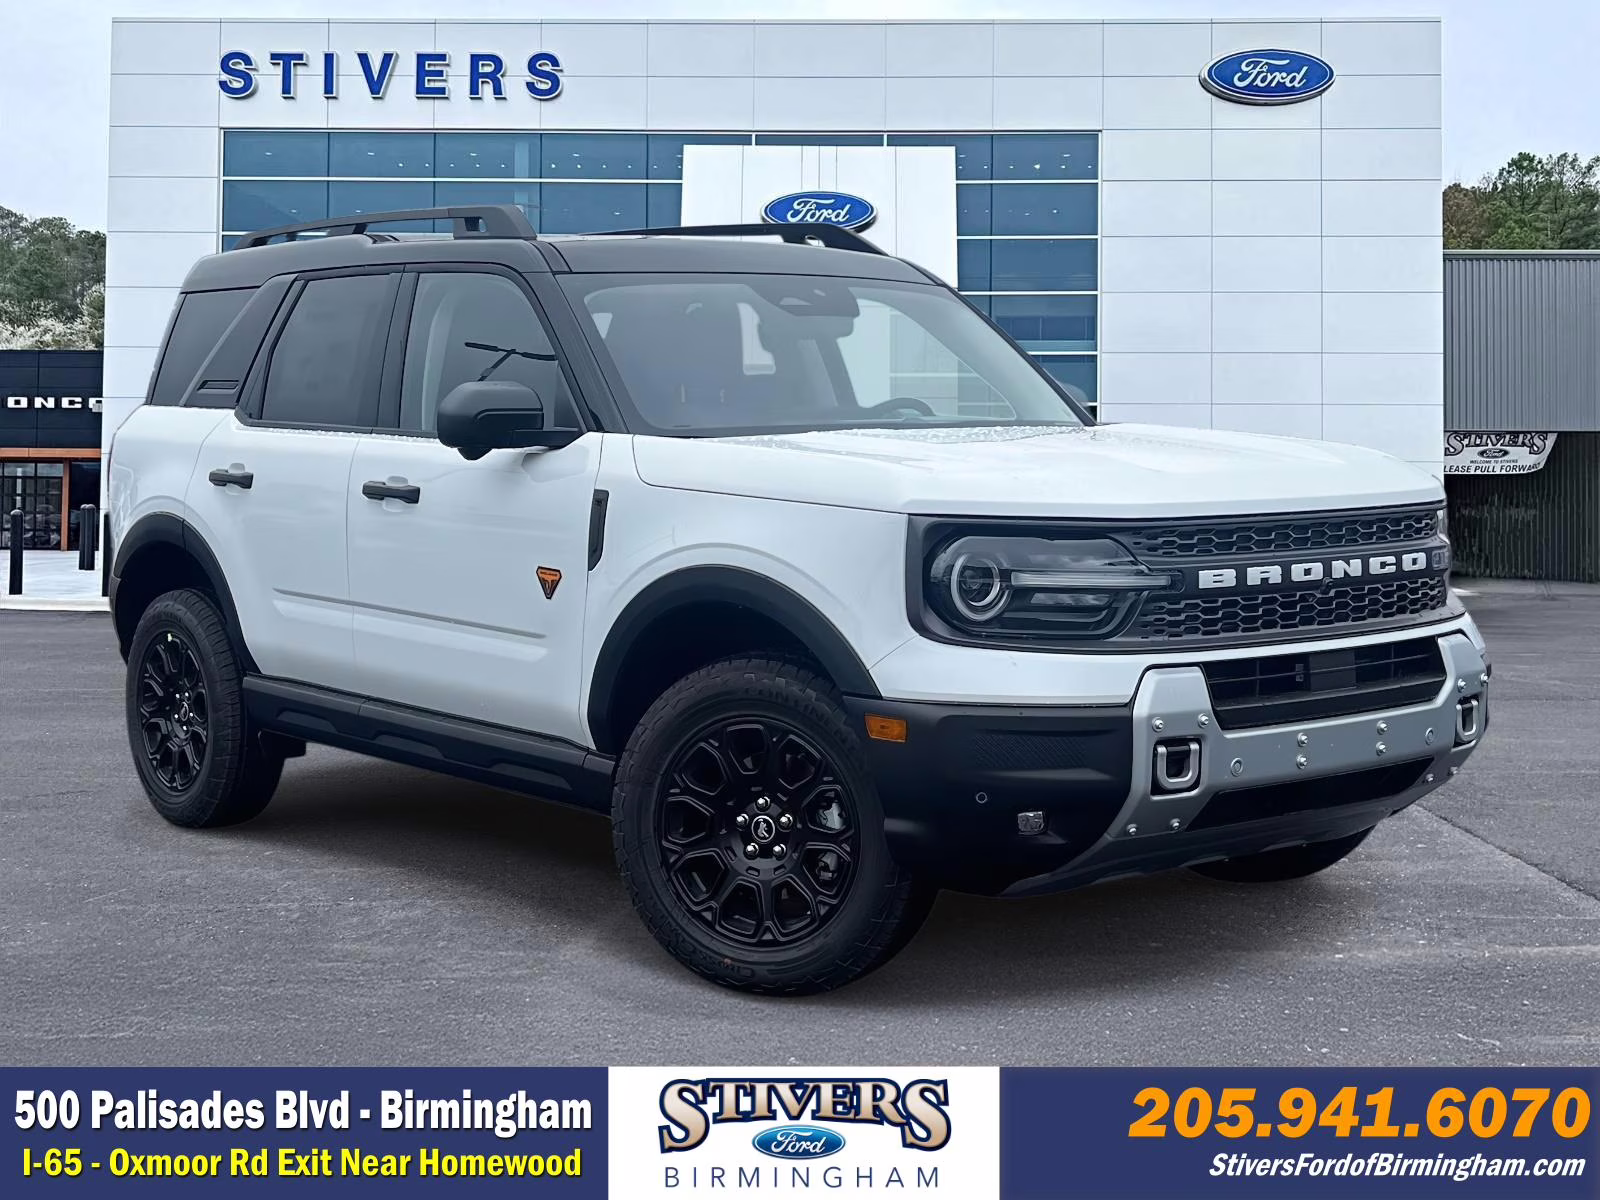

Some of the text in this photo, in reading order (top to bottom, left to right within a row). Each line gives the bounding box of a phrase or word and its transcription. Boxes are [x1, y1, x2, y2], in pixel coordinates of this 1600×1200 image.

[218, 50, 564, 100] STIVERS
[1233, 58, 1309, 88] Ford
[787, 198, 851, 222] Ford
[1444, 431, 1548, 456] STIVERS
[1483, 448, 1504, 457] Ford
[1474, 465, 1497, 473] PULL
[1198, 552, 1427, 589] BRONCO
